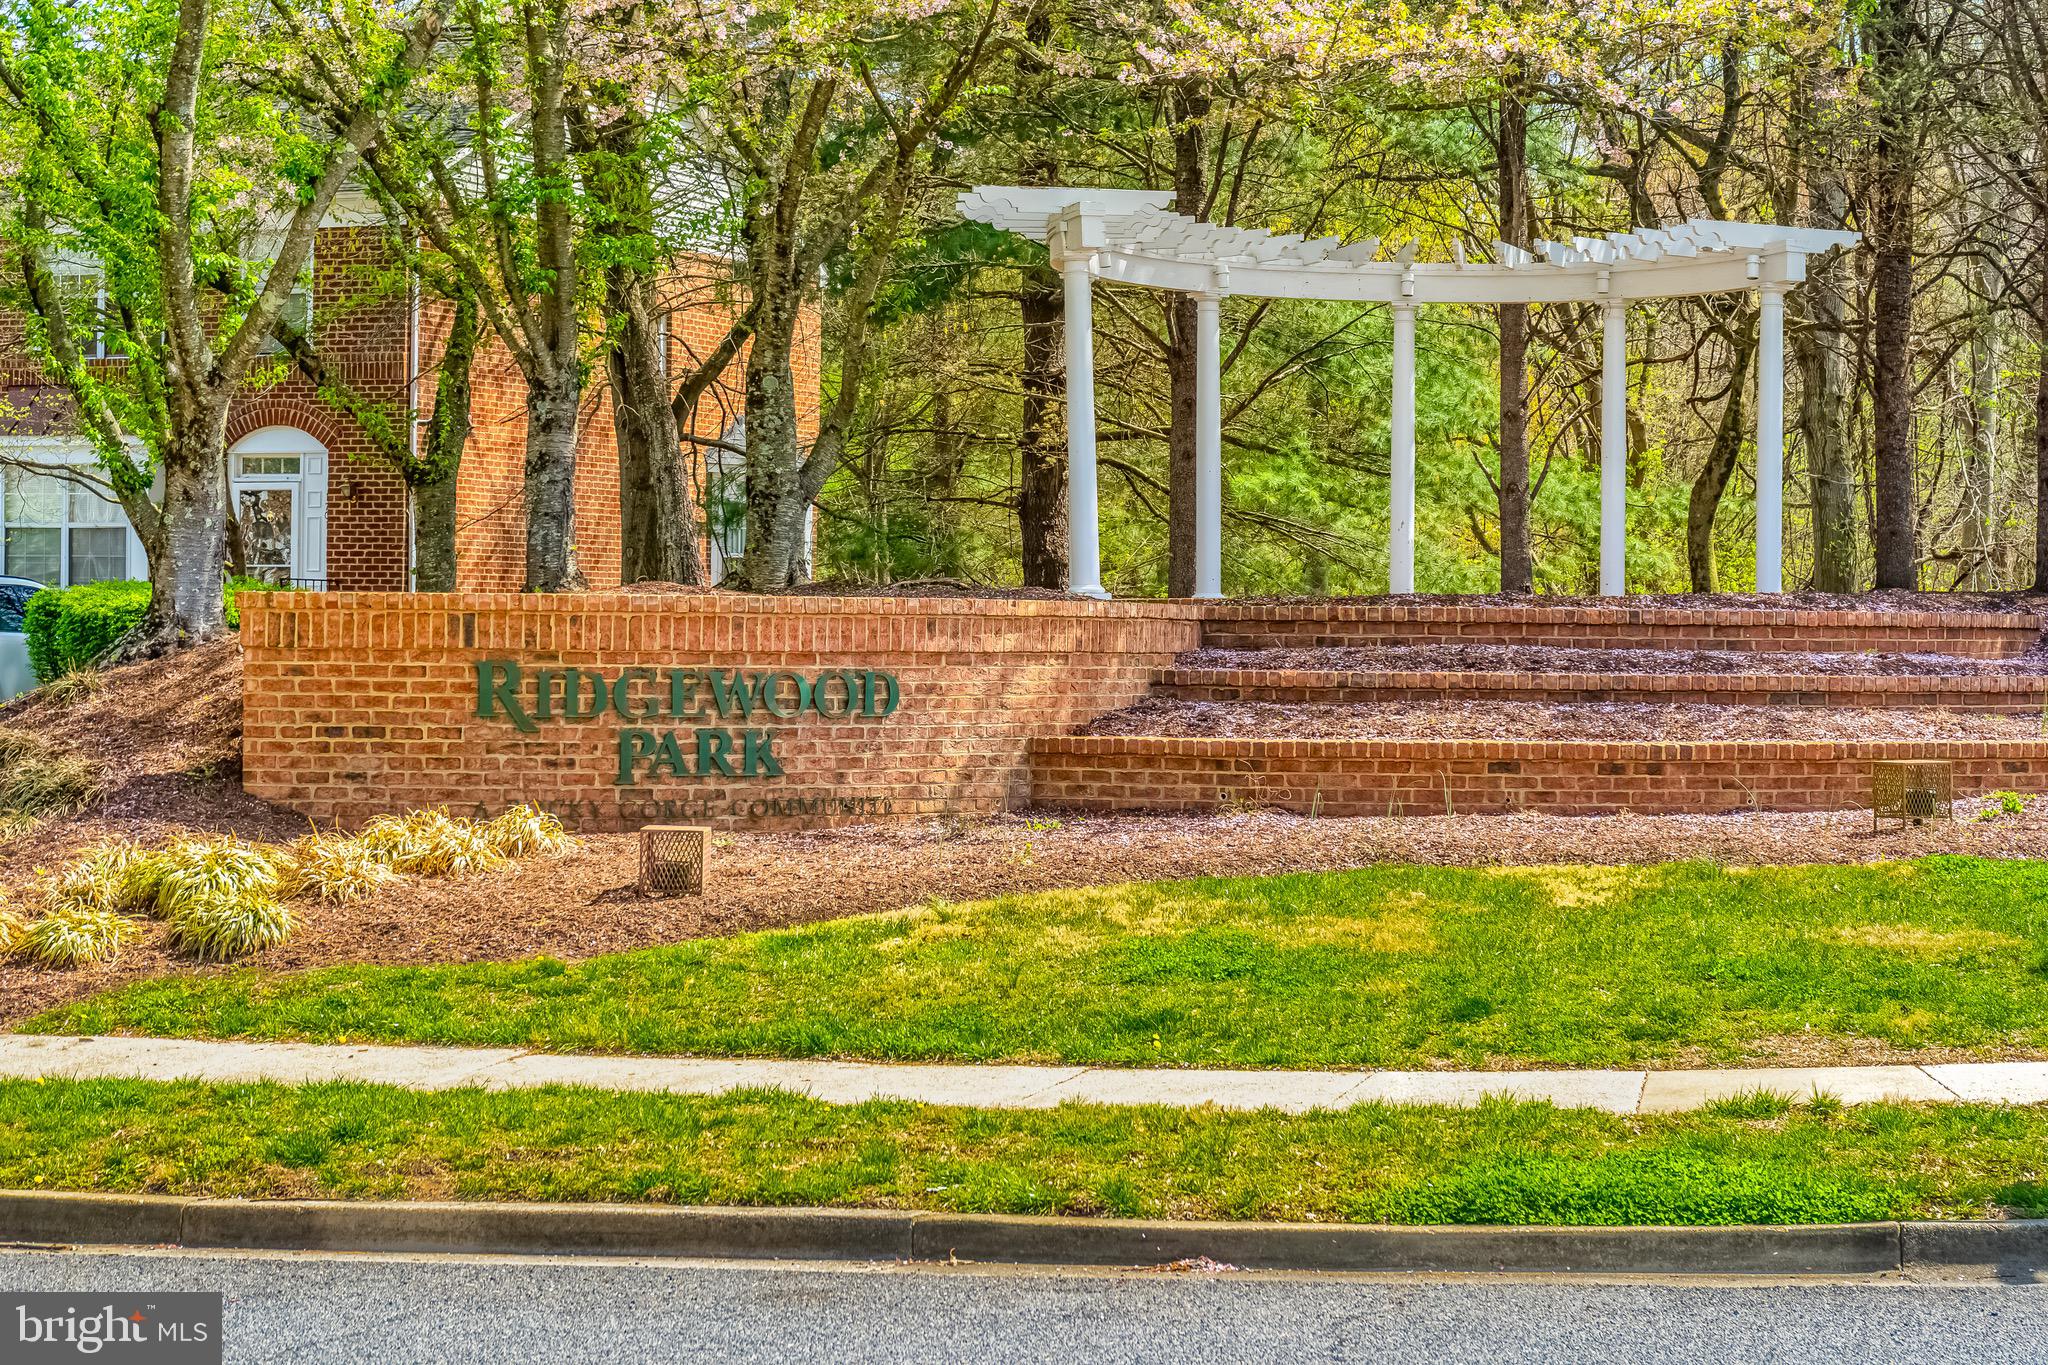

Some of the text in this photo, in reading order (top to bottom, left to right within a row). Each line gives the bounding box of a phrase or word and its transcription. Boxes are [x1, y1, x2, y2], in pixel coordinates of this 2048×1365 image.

[475, 660, 900, 732] RIDGEWOOD
[613, 728, 785, 786] PARK
[732, 796, 892, 818] COMMUNITY
